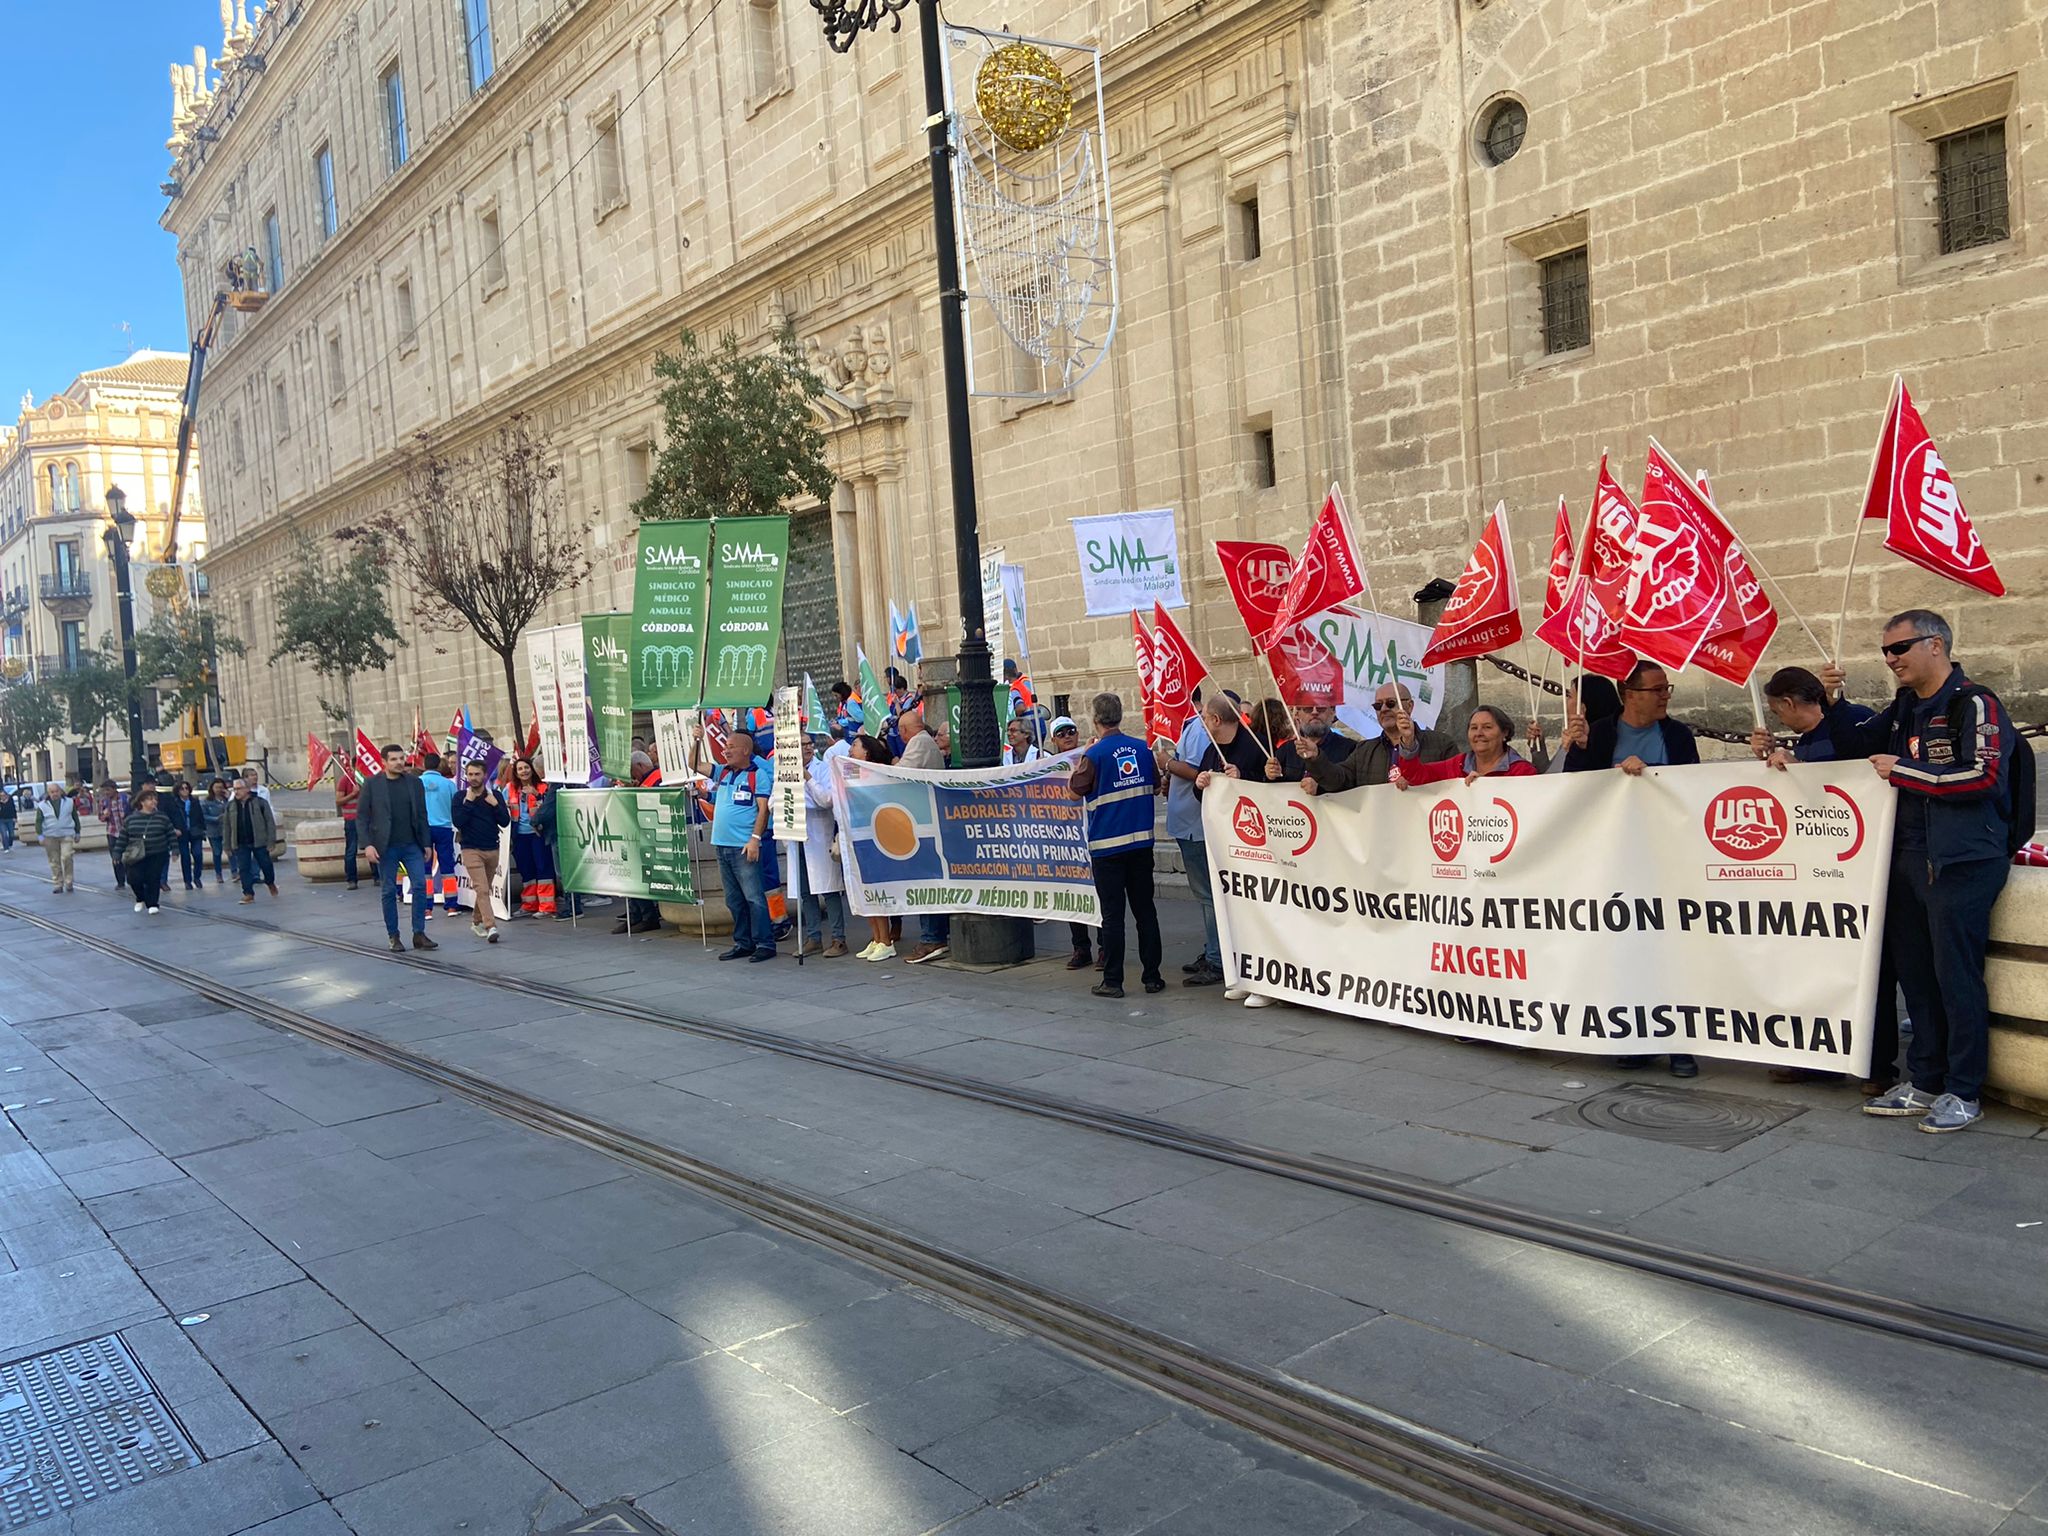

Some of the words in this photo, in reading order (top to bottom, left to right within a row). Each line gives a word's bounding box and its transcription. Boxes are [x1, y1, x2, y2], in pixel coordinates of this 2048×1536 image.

[644, 544, 698, 567] SMA
[721, 541, 776, 564] SMA
[1086, 535, 1168, 577] SMA
[648, 581, 696, 591] SINDICATO
[726, 579, 773, 589] SINDICATO
[1143, 581, 1175, 591] Málaga
[653, 592, 689, 603] MÉDICO
[731, 591, 766, 601] MÉDICO
[649, 606, 692, 616] ANDALUZ
[727, 605, 768, 615] ANDALUZ
[641, 621, 694, 633] CÓRDOBA
[720, 621, 769, 632] CÓRDOBA
[1434, 624, 1510, 653] www.ugt.es
[1001, 786, 1023, 798] LAS
[944, 804, 1016, 820] LABORALES
[1018, 805, 1027, 819] Y
[1714, 797, 1776, 828] UGT
[1794, 805, 1850, 821] Servicios
[1266, 815, 1306, 826] Servicios
[1432, 809, 1459, 833] UGT
[1467, 816, 1509, 828] Servicios
[965, 824, 982, 839] DE
[986, 823, 1011, 839] LAS
[1013, 823, 1080, 841] URGENCIAS
[1268, 827, 1303, 839] Públicos
[1795, 821, 1850, 837] Públicos
[1467, 831, 1504, 842] Públicos
[976, 840, 1040, 860] ATENCIÓN
[1037, 865, 1054, 877] DEL
[1055, 866, 1091, 880] ACUERDO
[1473, 868, 1497, 878] Sevilla
[1718, 865, 1784, 878] Andalucía
[1812, 868, 1844, 879] Sevilla
[906, 887, 973, 906] SINDICATO
[976, 885, 1028, 909] MÉDICO
[1033, 891, 1049, 910] DE
[1053, 889, 1095, 914] MÁLAGA
[1220, 869, 1349, 914] SERVICIOS
[1353, 889, 1475, 928] URGENCIAS
[1482, 892, 1666, 932] ATENCIÓN
[1430, 941, 1528, 981] EXIGEN
[1338, 973, 1544, 1034] PROFESIONALES
[1549, 1003, 1570, 1036] Y
